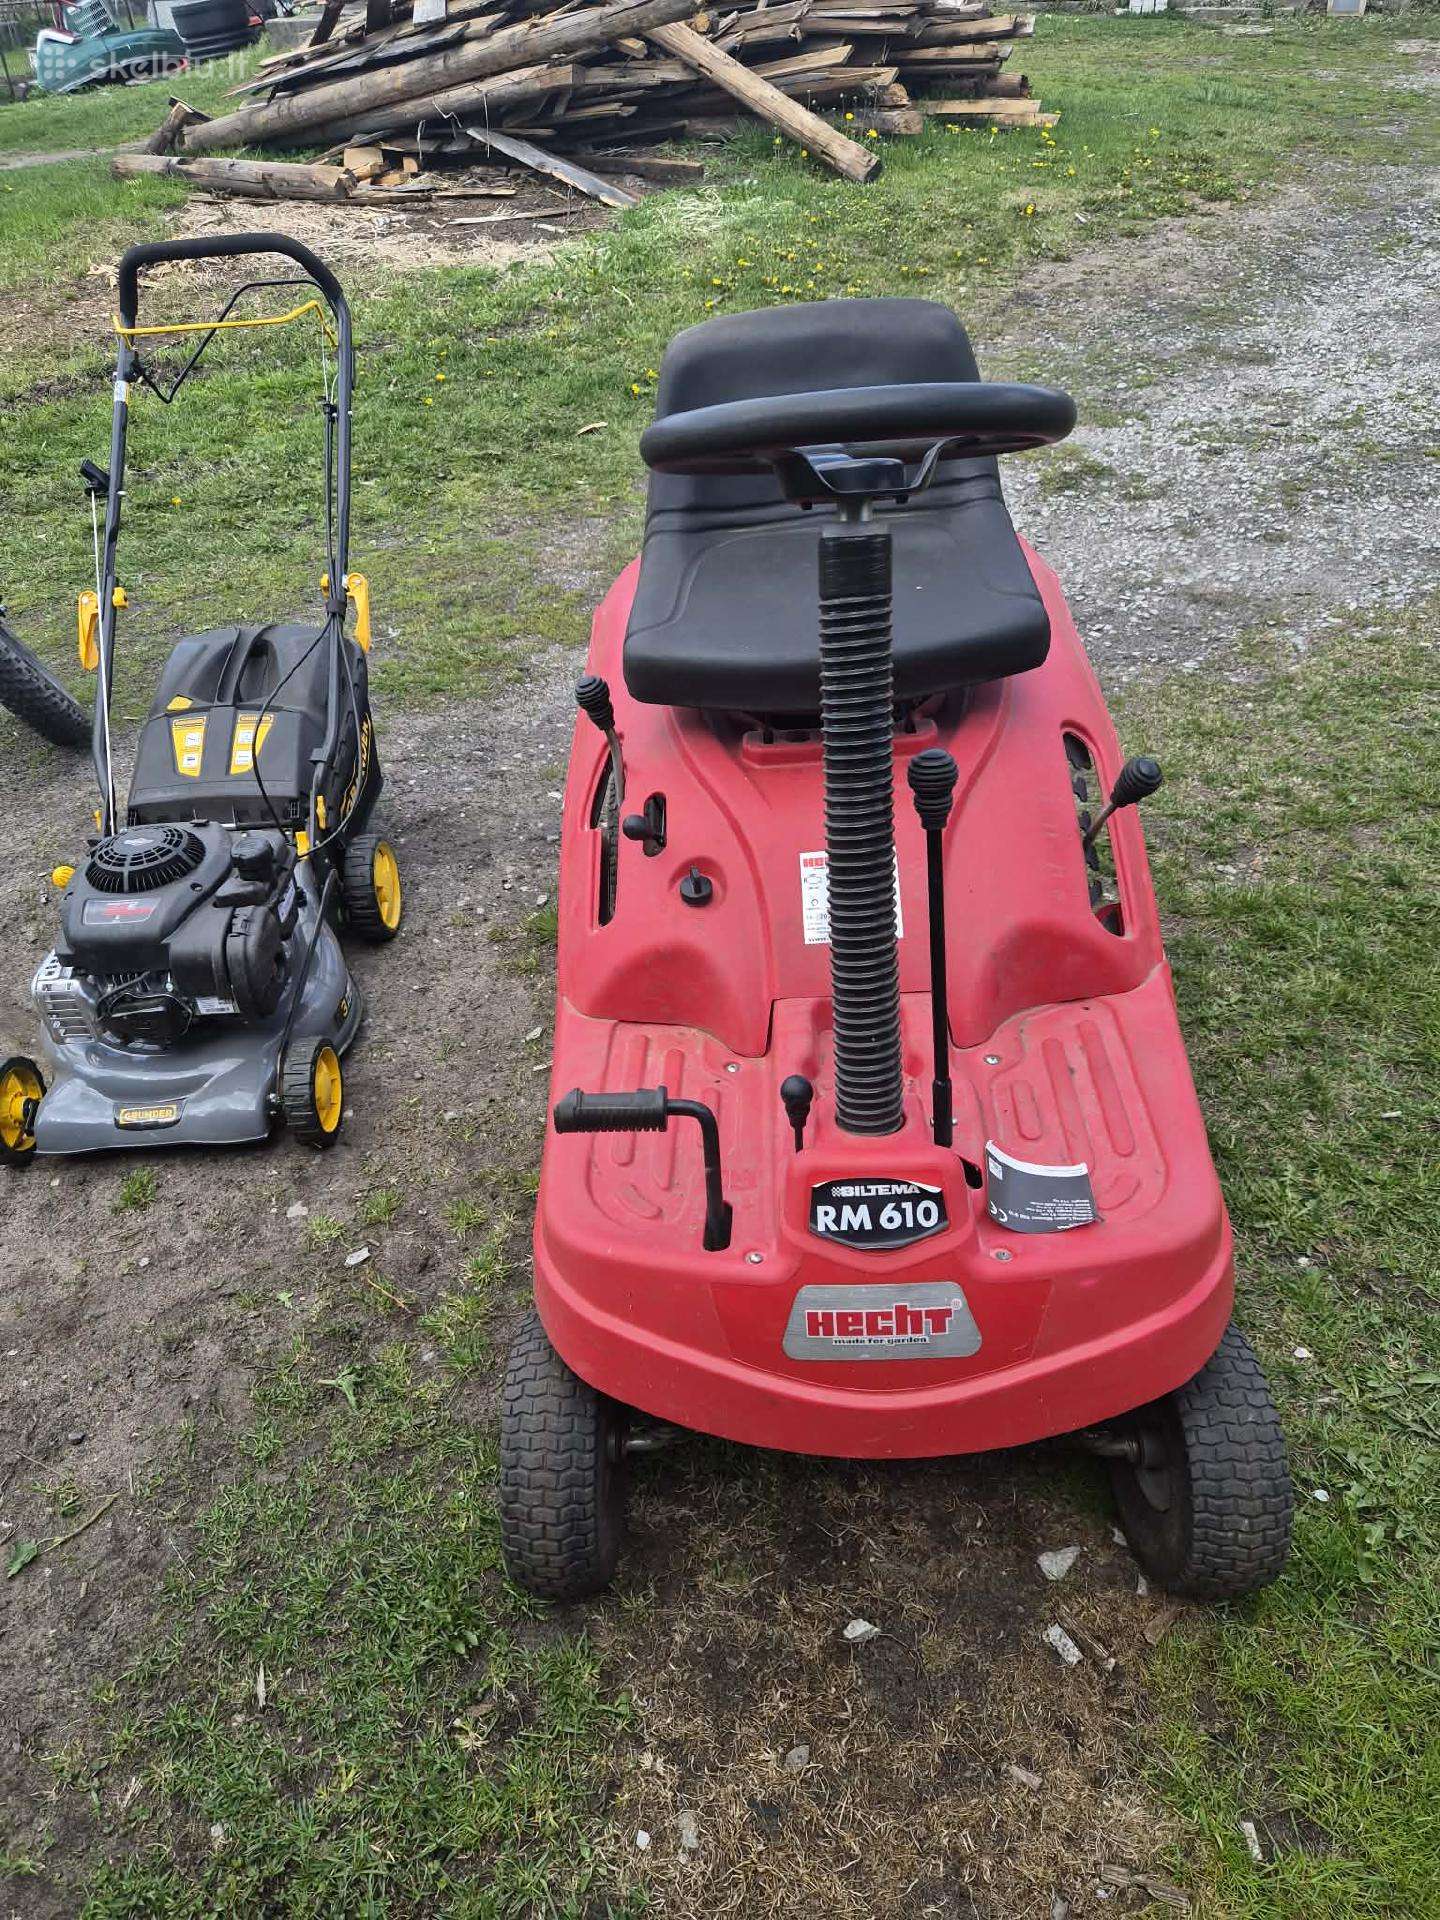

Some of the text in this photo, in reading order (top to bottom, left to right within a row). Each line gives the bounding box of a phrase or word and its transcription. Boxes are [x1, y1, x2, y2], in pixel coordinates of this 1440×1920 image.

[839, 1184, 921, 1197] BILTEMA
[816, 1200, 939, 1231] RM 610
